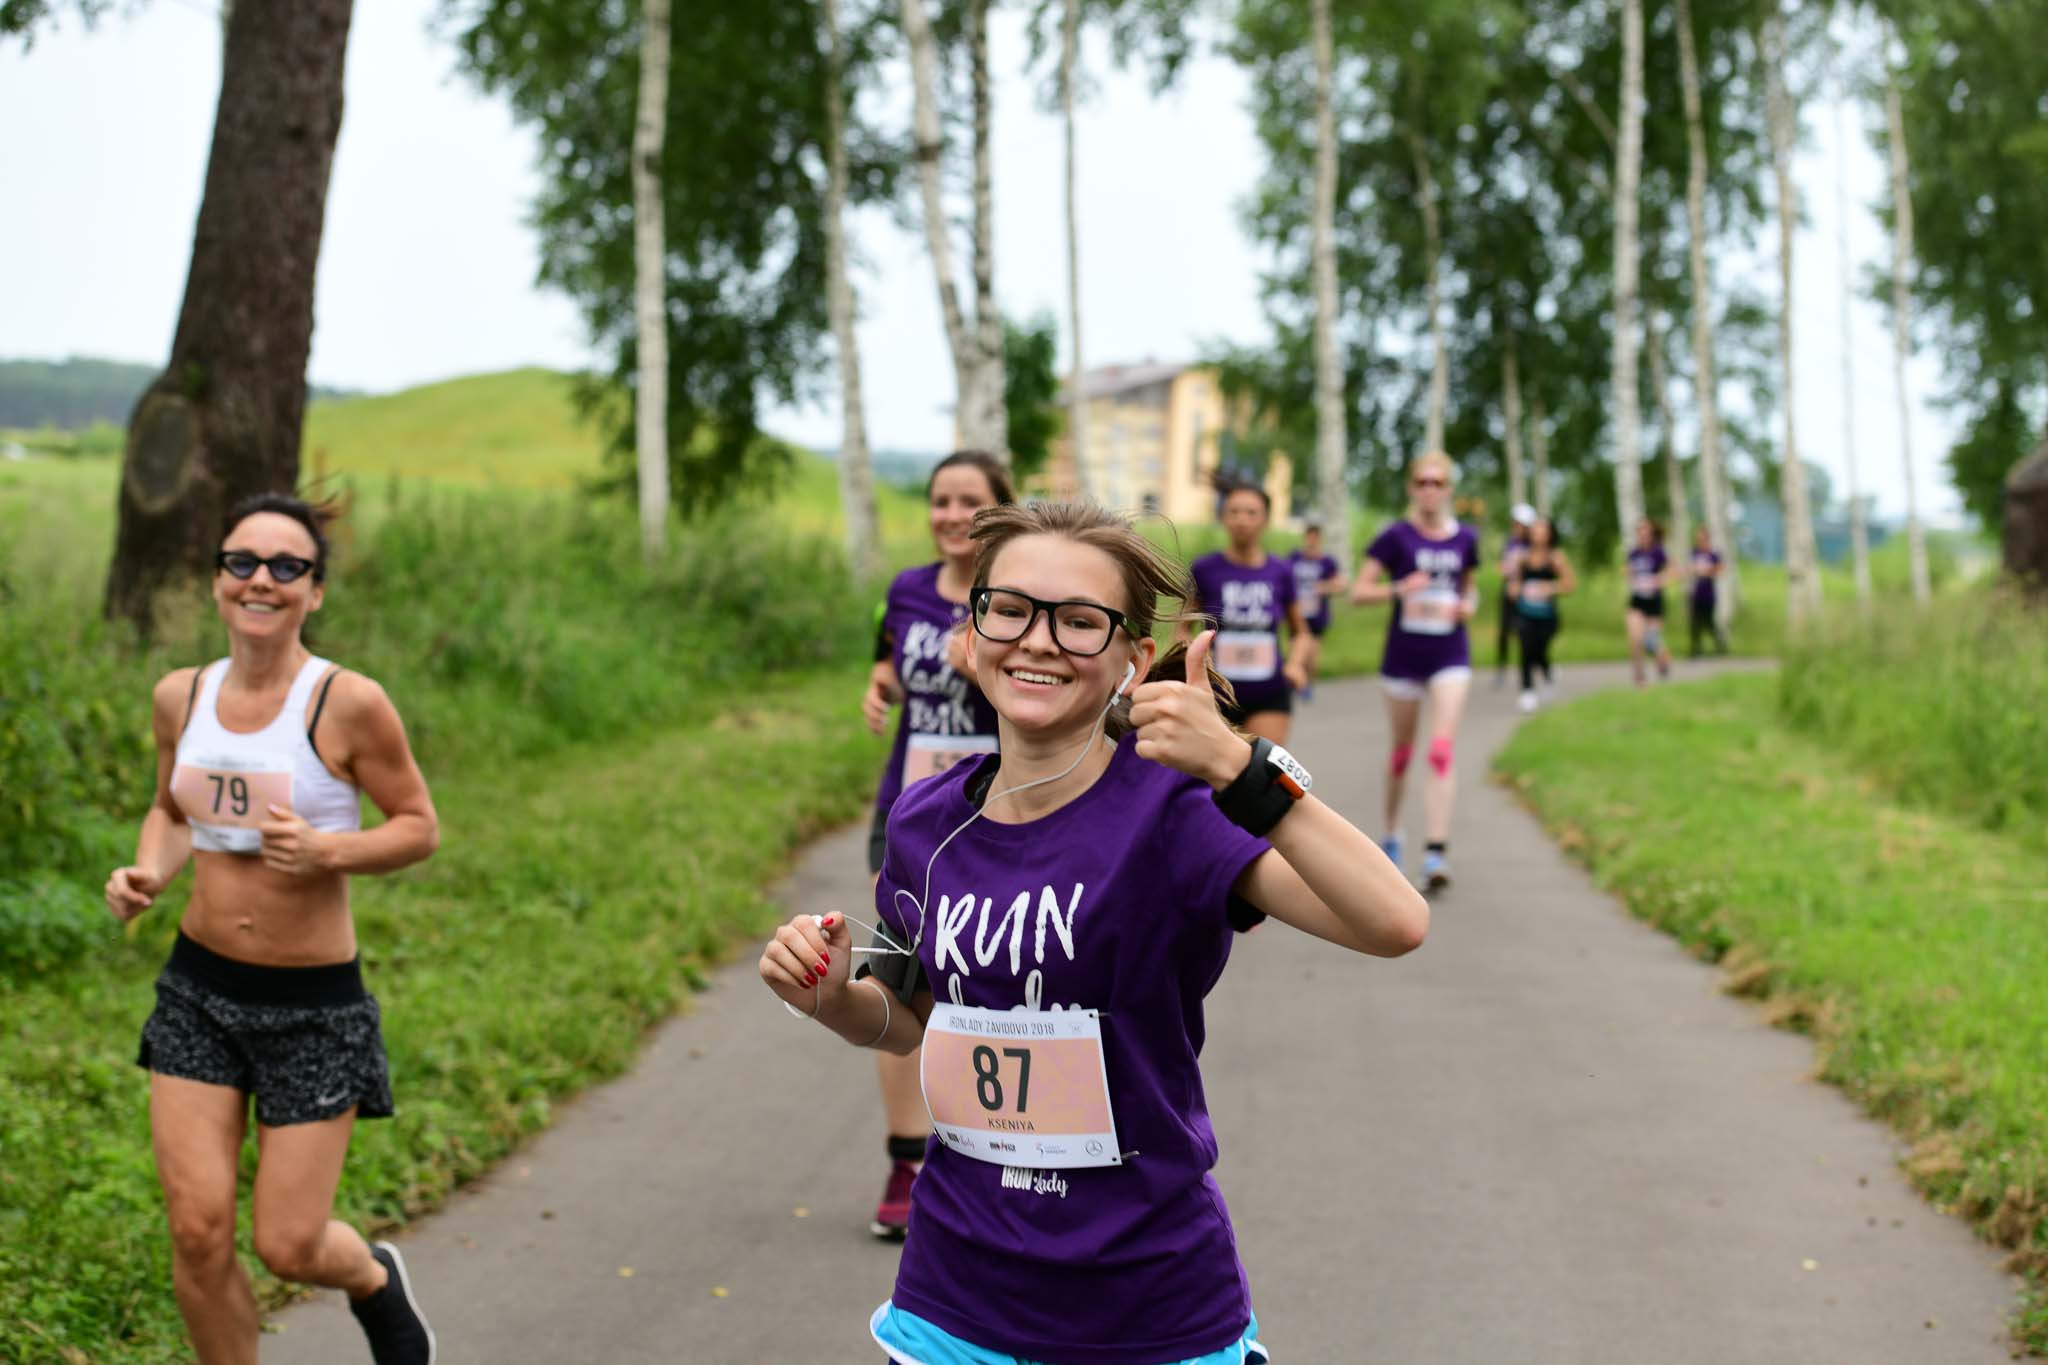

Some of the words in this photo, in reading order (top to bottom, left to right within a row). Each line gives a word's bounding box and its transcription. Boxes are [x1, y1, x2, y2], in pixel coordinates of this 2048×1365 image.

[1277, 754, 1311, 788] 0087
[207, 773, 249, 816] 79
[934, 882, 1083, 976] RUN
[949, 1015, 984, 1034] IRONLADY
[985, 1021, 1028, 1036] ZAVIDOVO
[1030, 1022, 1055, 1036] 2018
[972, 1044, 1032, 1113] 87
[988, 1117, 1035, 1132] KSENIYA
[1001, 1166, 1033, 1190] IRON
